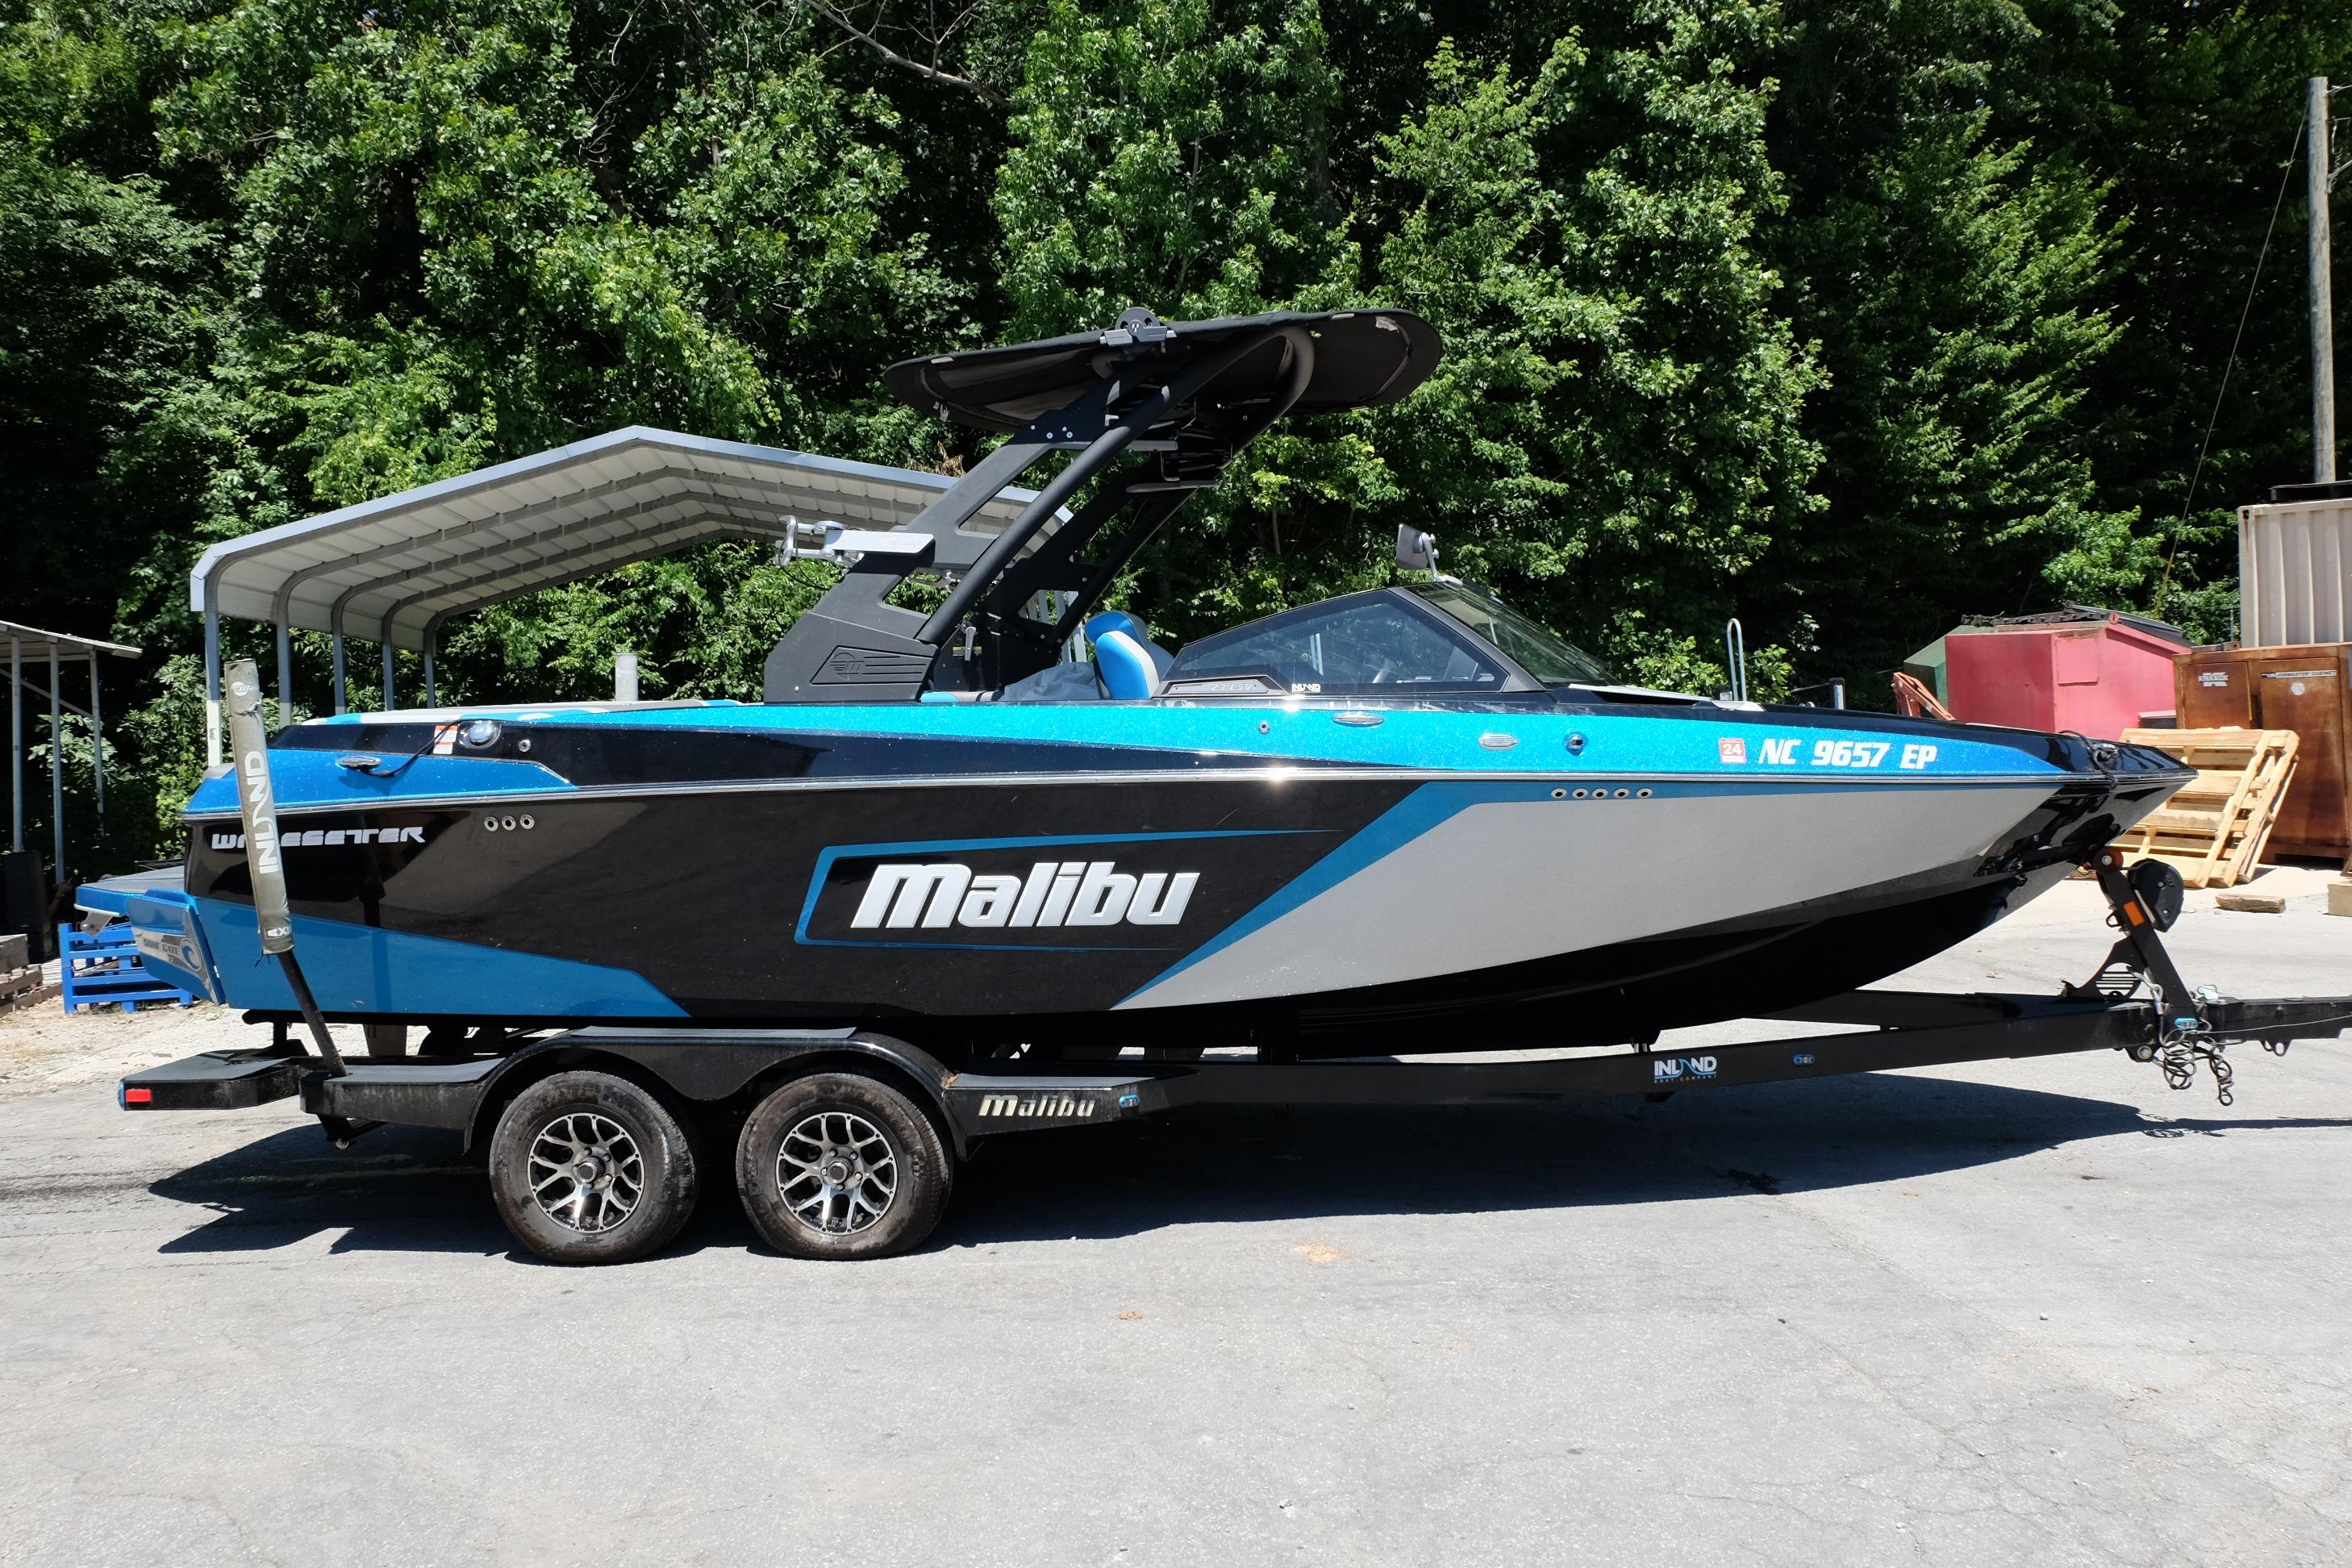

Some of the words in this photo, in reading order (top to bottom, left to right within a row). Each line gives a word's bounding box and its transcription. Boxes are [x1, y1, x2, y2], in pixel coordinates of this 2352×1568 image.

[1723, 743, 1742, 755] 24
[1758, 739, 1801, 765] NC
[1811, 740, 1891, 767] 9657
[1900, 744, 1937, 769] EP
[851, 861, 1200, 928] Malibu
[978, 1095, 1095, 1116] Malibu
